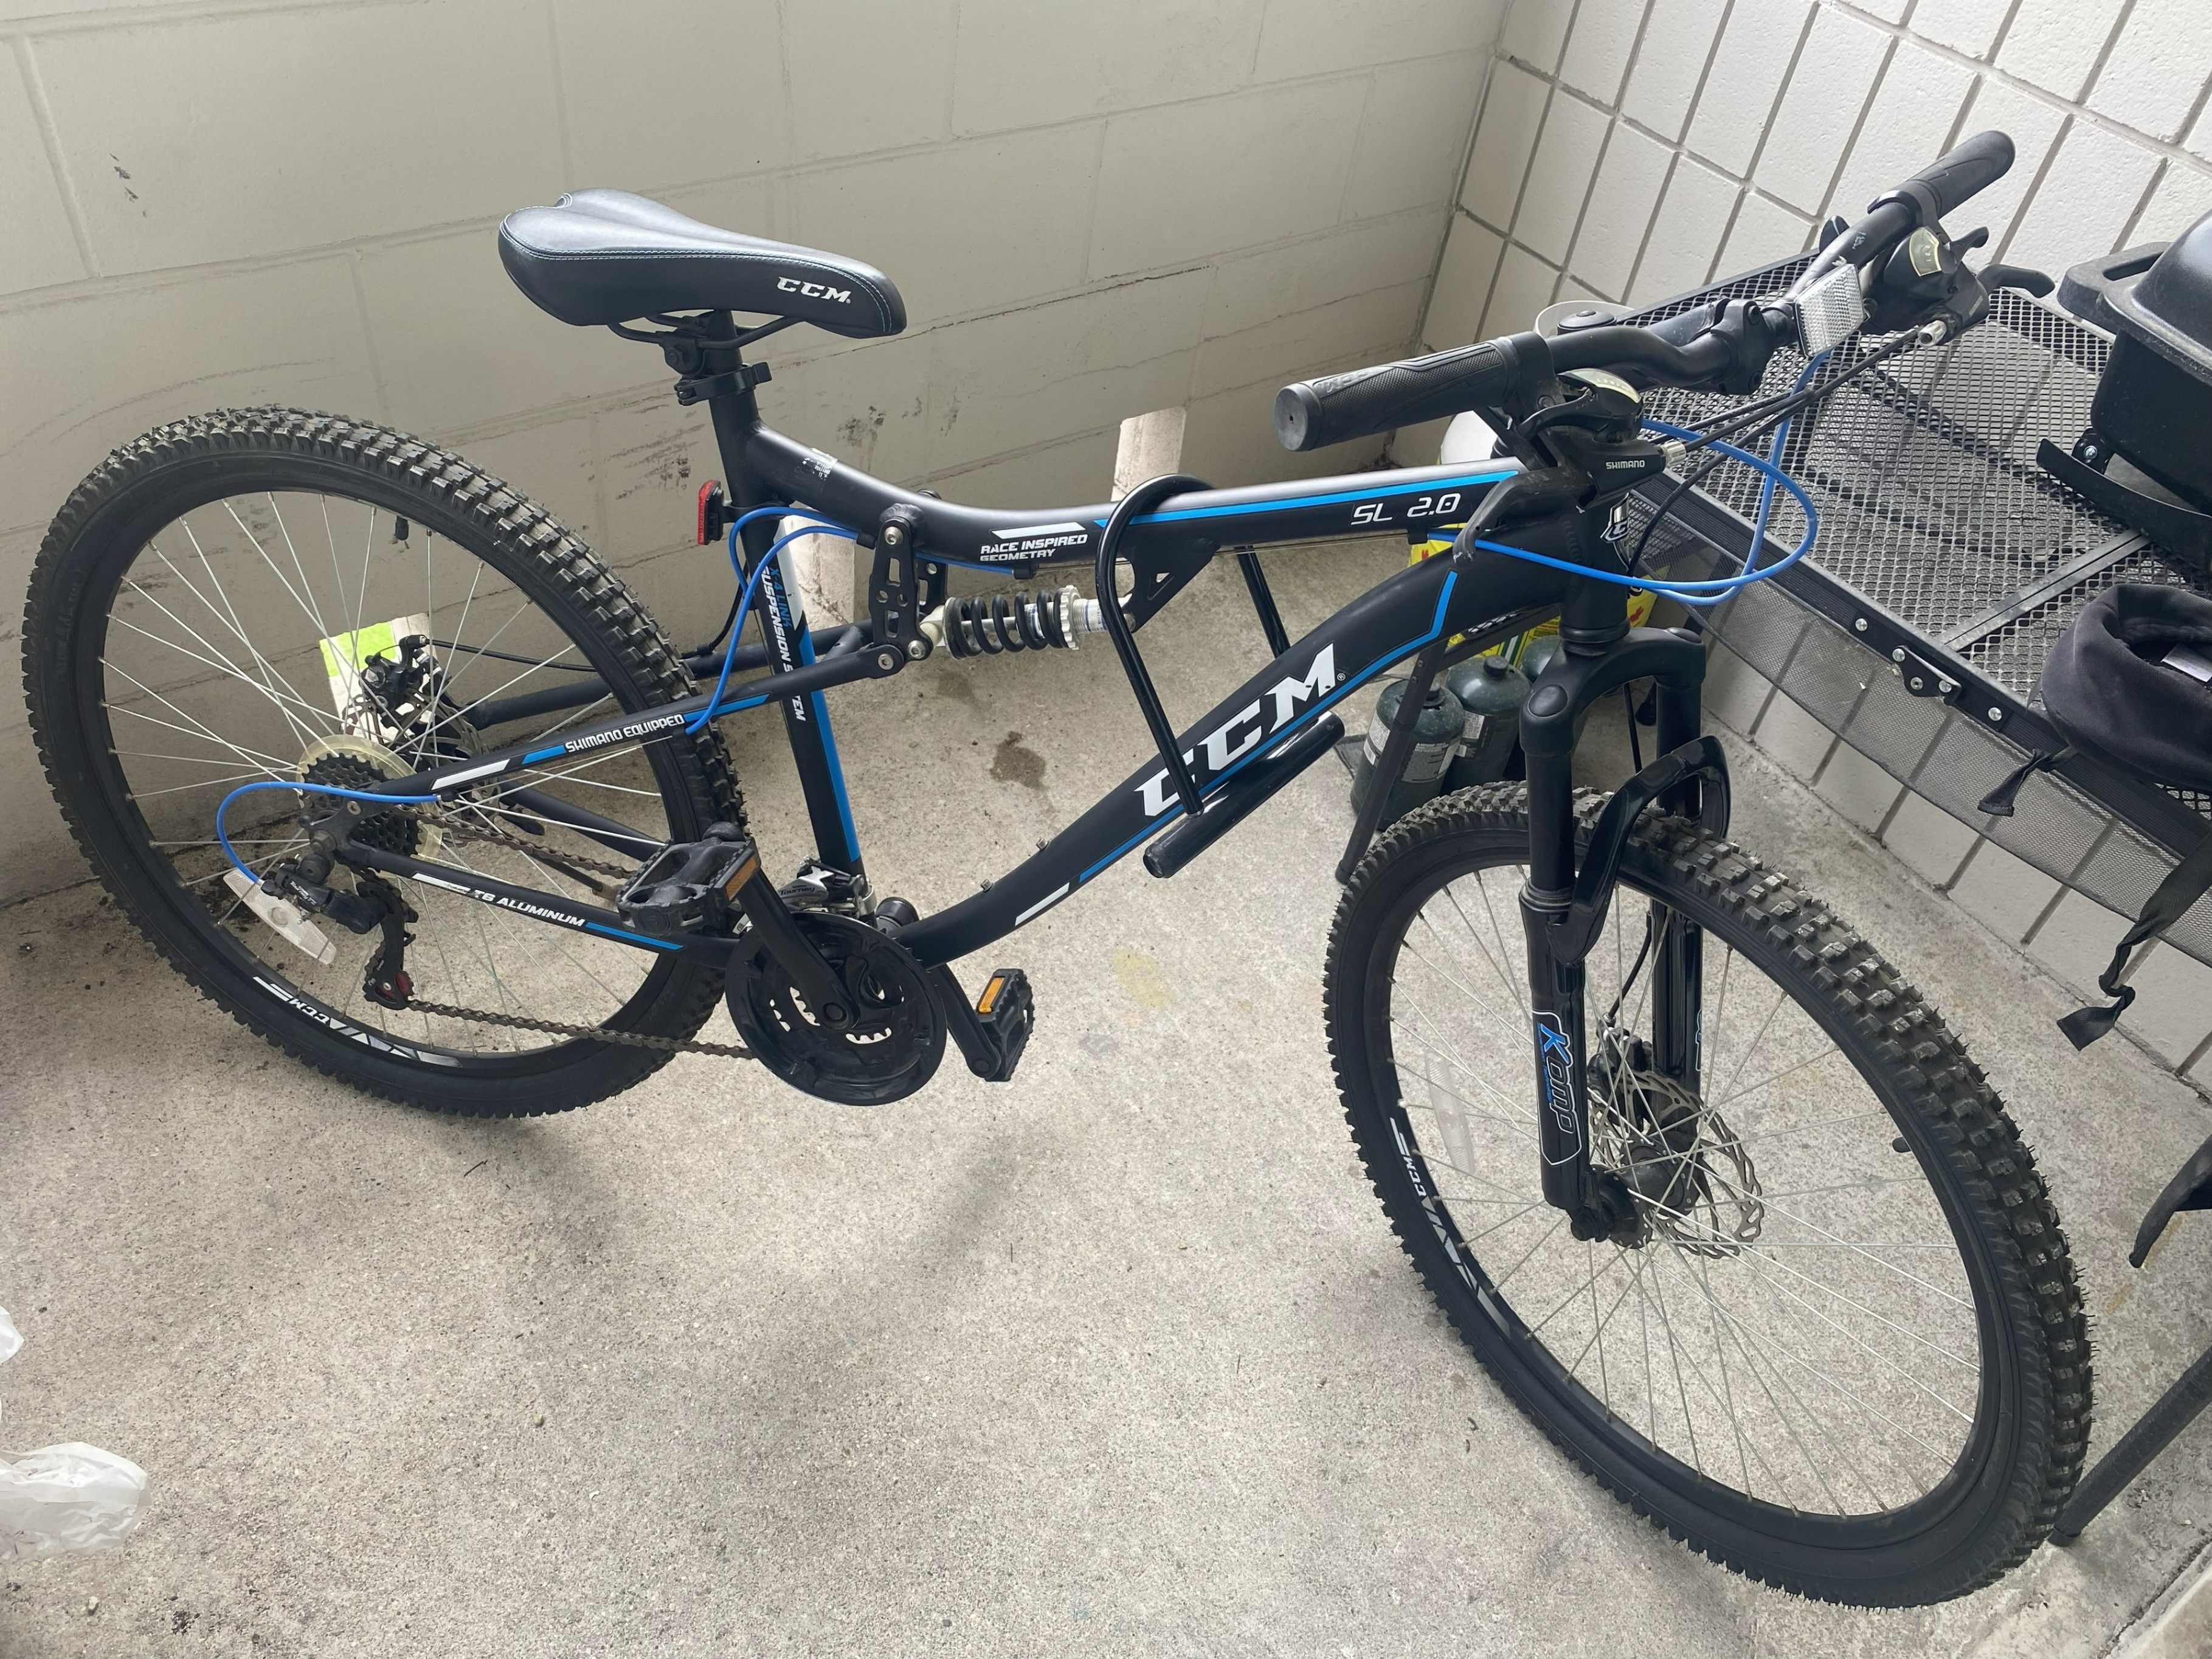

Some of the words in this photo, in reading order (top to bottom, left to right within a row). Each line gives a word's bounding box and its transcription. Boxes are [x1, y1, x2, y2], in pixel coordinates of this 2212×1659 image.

[777, 276, 851, 303] CCM
[1605, 460, 1645, 469] SHIMANO
[1350, 503, 1393, 525] SL
[1407, 493, 1461, 518] 2.0
[980, 541, 1019, 554] RACE
[1021, 534, 1088, 550] INSPIRED
[980, 549, 1057, 561] GEOMETRY
[776, 594, 793, 628] LINK
[565, 729, 623, 753] SHIMANO
[623, 714, 685, 738] EQUIPPED
[1133, 642, 1336, 817] CCM
[778, 887, 815, 896] Tourney
[496, 897, 586, 927] ALUMINUM
[289, 998, 330, 1024] CCM
[1540, 1023, 1576, 1134] Komp
[1403, 1156, 1427, 1197] CCM
